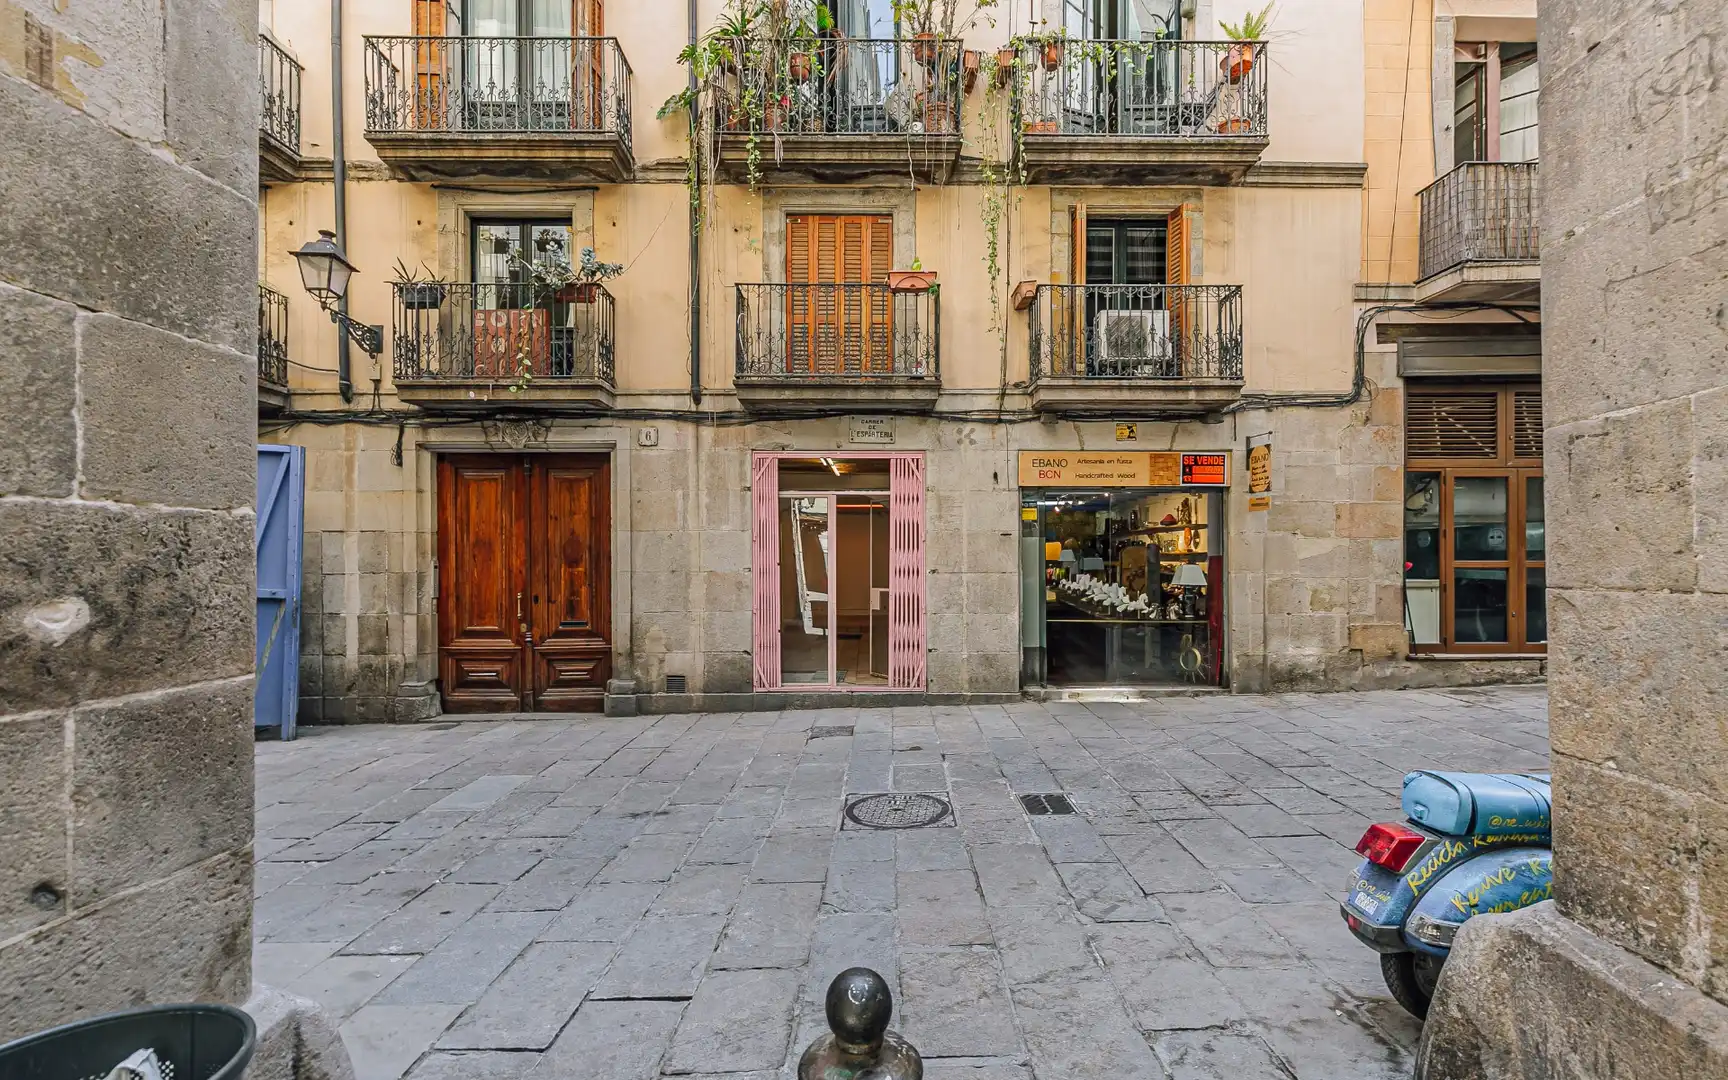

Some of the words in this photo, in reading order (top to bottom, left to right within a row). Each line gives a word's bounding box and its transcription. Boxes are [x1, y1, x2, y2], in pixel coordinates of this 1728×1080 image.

[645, 430, 652, 441] 6
[1032, 458, 1068, 468] EBANO
[1183, 456, 1195, 465] SE
[1196, 456, 1224, 465] VENDE
[1038, 470, 1061, 479] BCN
